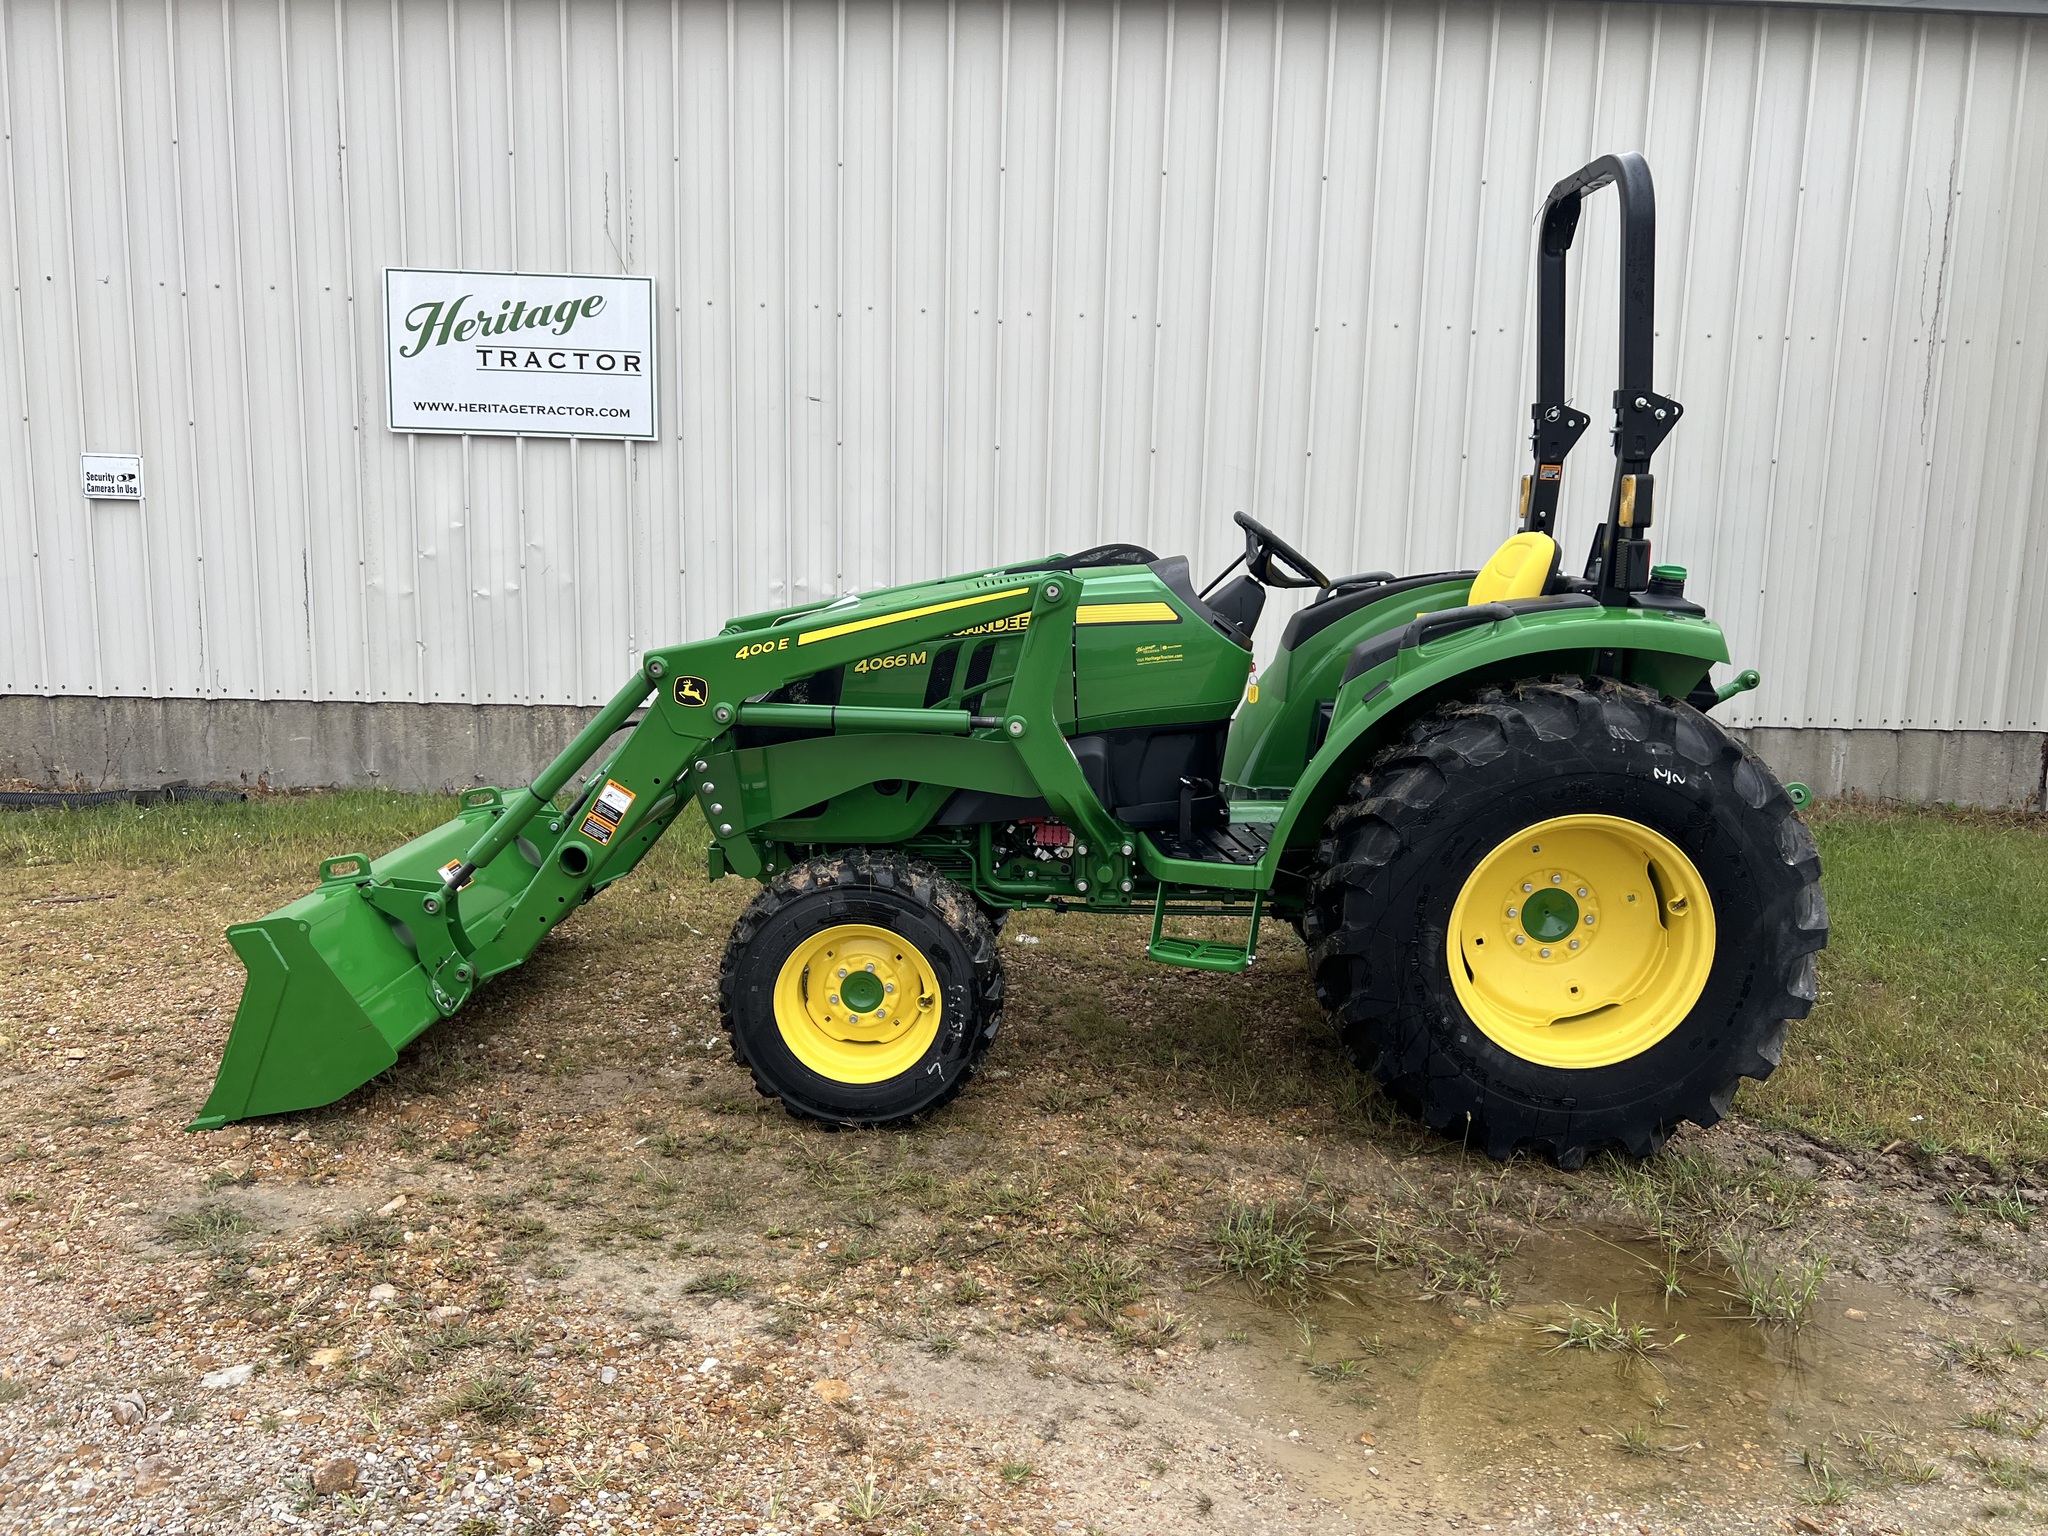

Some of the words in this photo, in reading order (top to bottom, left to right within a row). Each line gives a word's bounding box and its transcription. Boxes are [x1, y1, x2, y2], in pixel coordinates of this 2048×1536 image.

[399, 294, 607, 358] Heritage
[476, 349, 641, 372] TRACTOR
[413, 401, 630, 418] WWW.HERITAGETRACTOR.COM
[86, 471, 115, 484] Security
[86, 482, 115, 493] Cameras
[117, 484, 123, 493] In
[125, 484, 137, 494] Use
